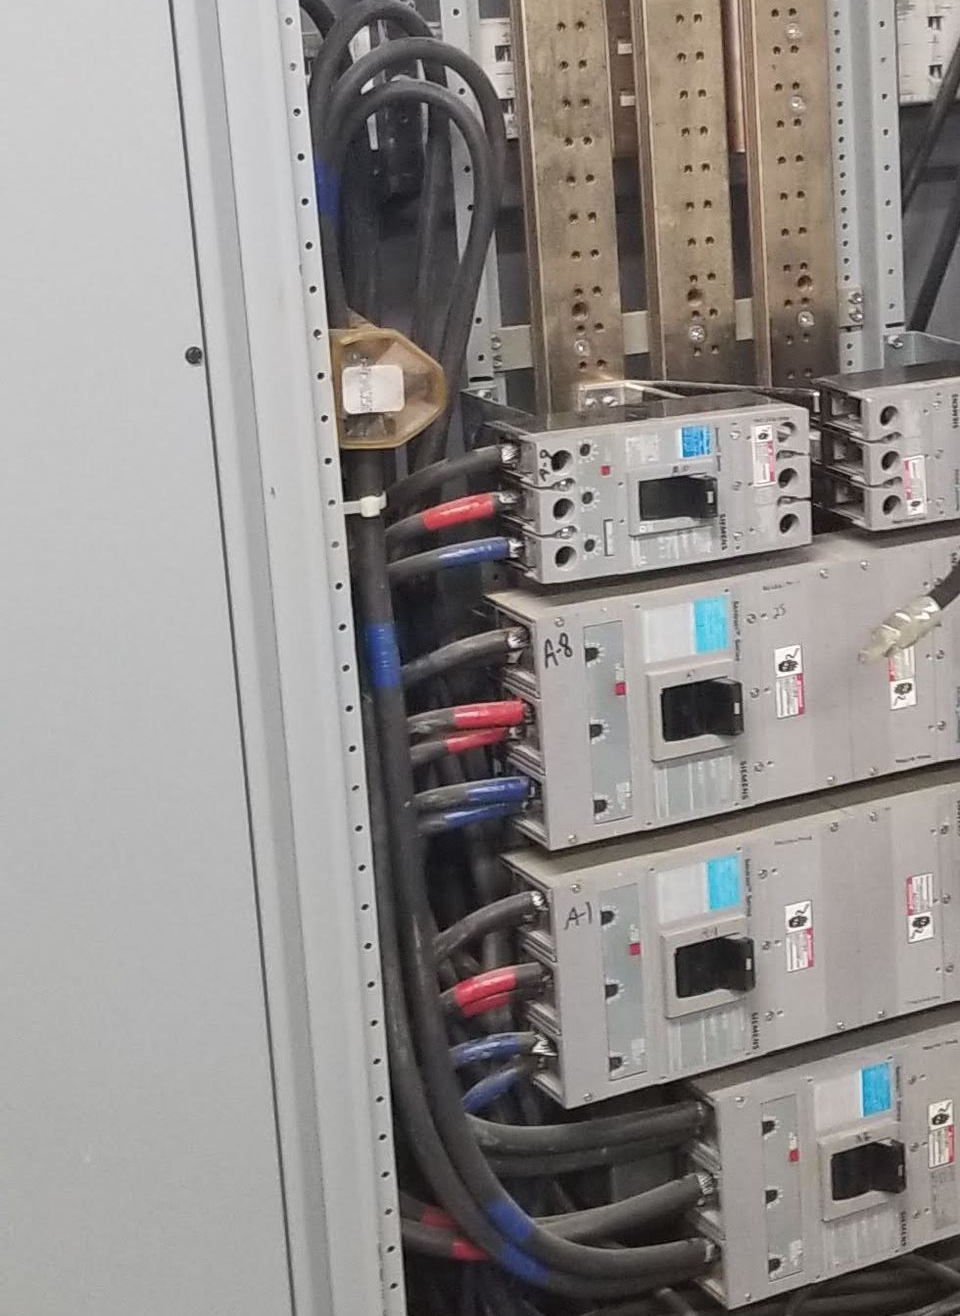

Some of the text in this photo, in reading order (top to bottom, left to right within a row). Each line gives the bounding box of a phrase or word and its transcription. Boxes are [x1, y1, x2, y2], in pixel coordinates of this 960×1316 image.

[719, 514, 728, 551] SIEMENS
[544, 632, 573, 669] A-8
[740, 761, 749, 800] SIEMENS
[564, 900, 593, 930] A-1
[752, 1012, 760, 1050] SIEMENS
